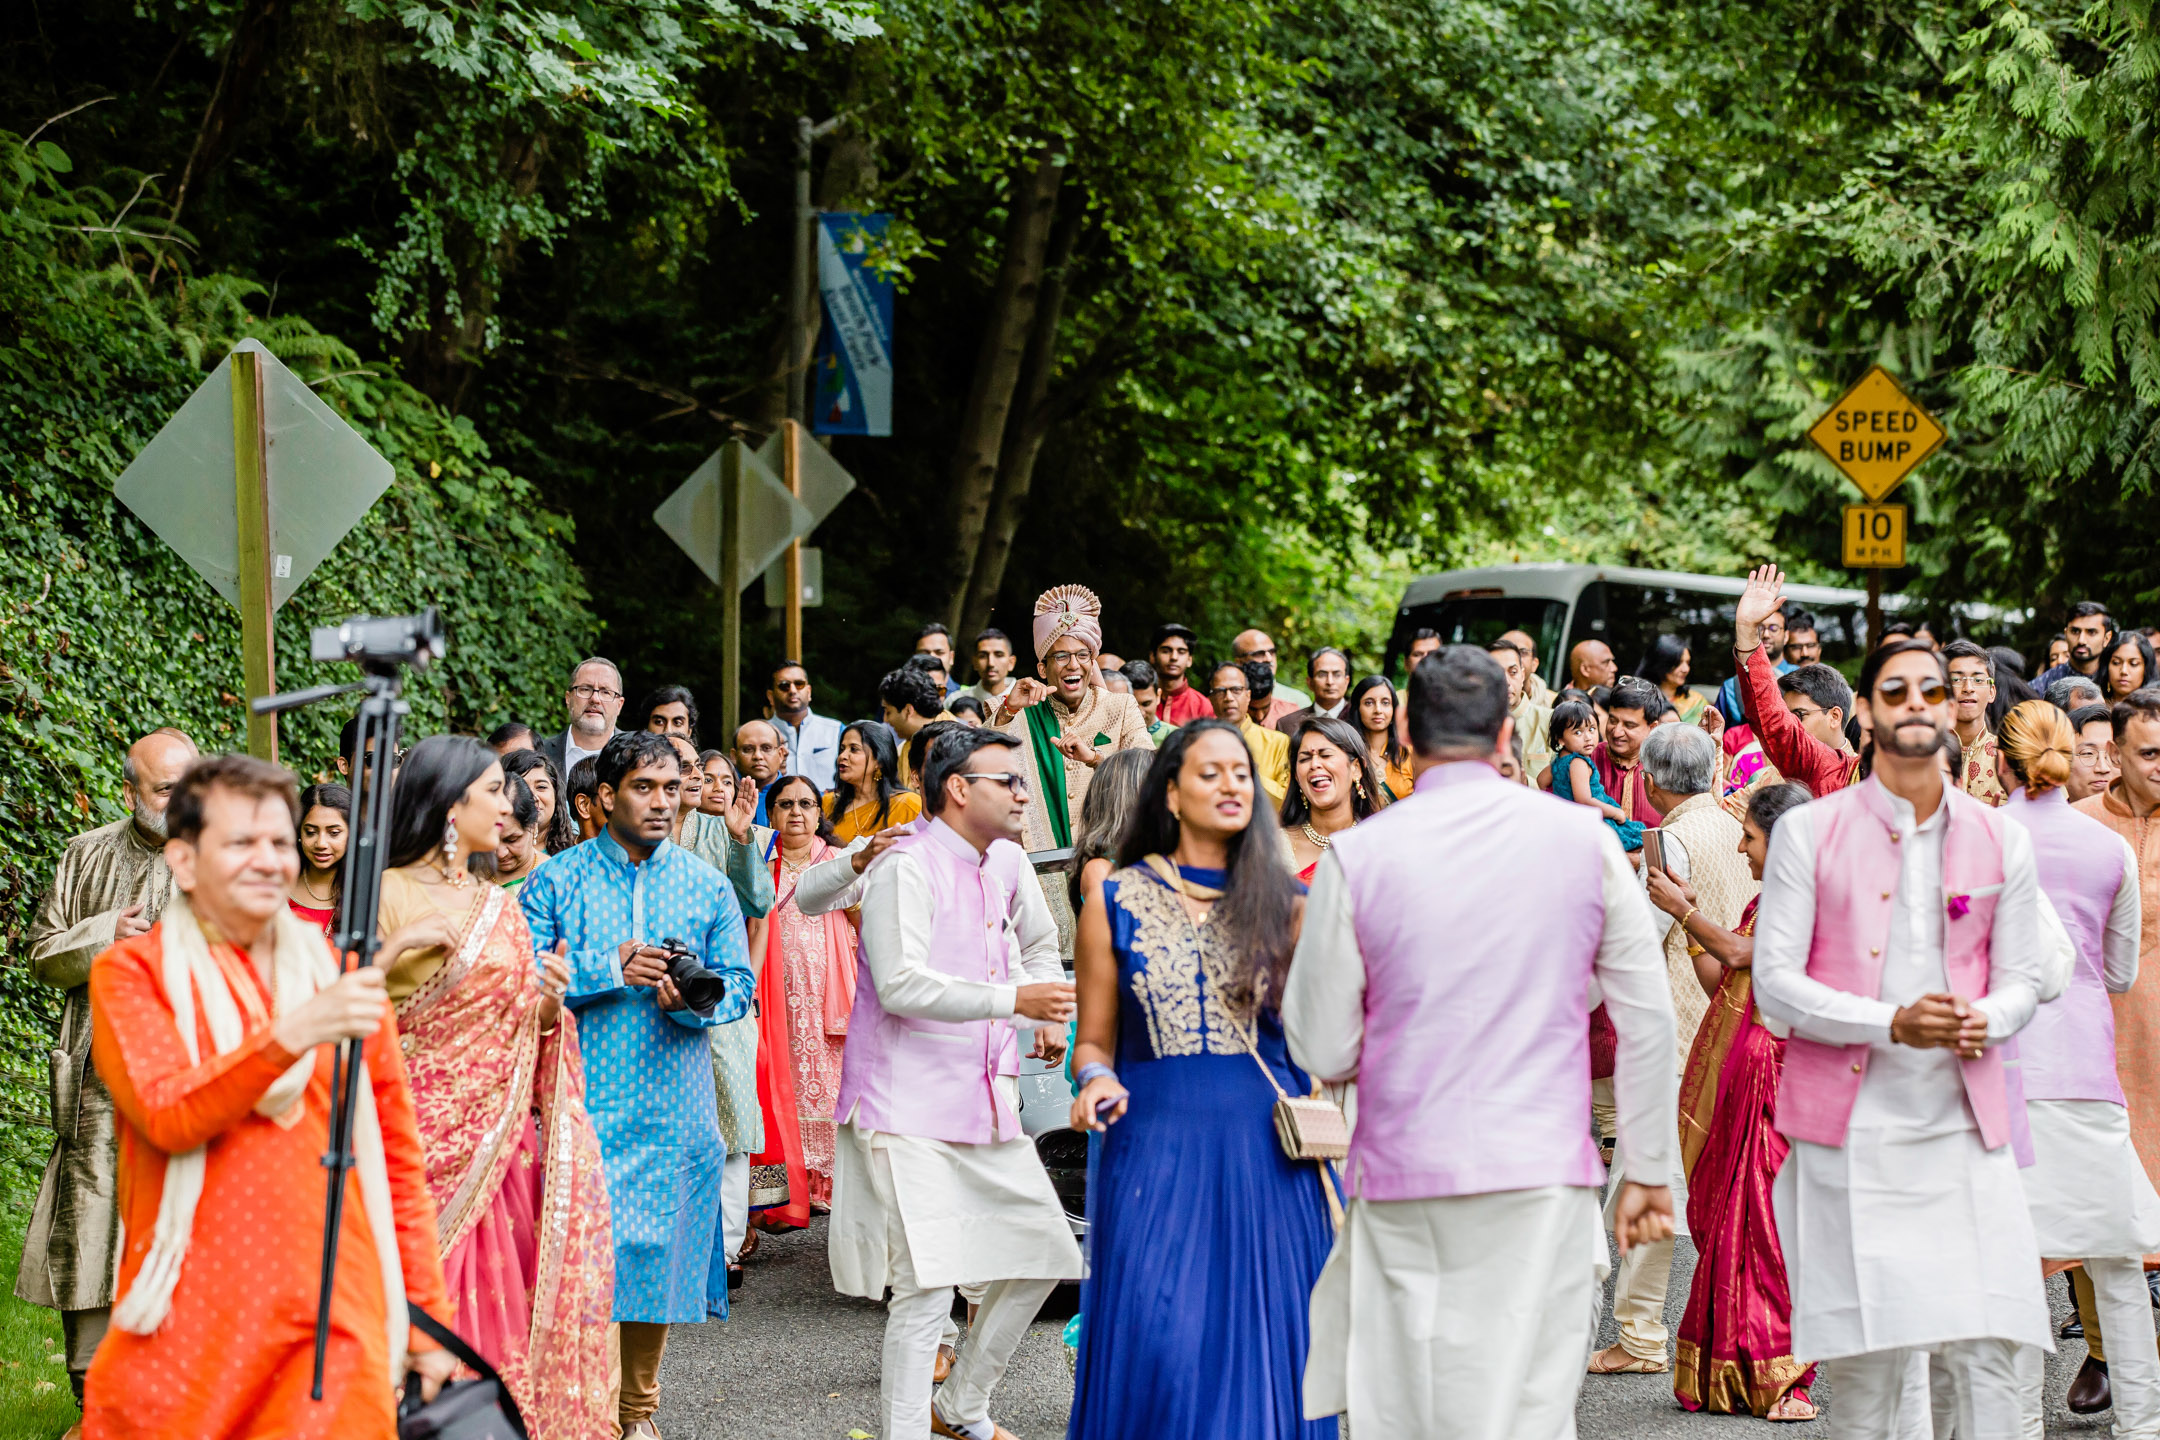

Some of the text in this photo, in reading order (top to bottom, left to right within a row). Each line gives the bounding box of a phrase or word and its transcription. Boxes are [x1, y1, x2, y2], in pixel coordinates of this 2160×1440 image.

[1836, 411, 1917, 433] SPEED
[1840, 441, 1911, 462] BUMP
[1858, 512, 1891, 541] 10
[1855, 547, 1891, 558] MPH
